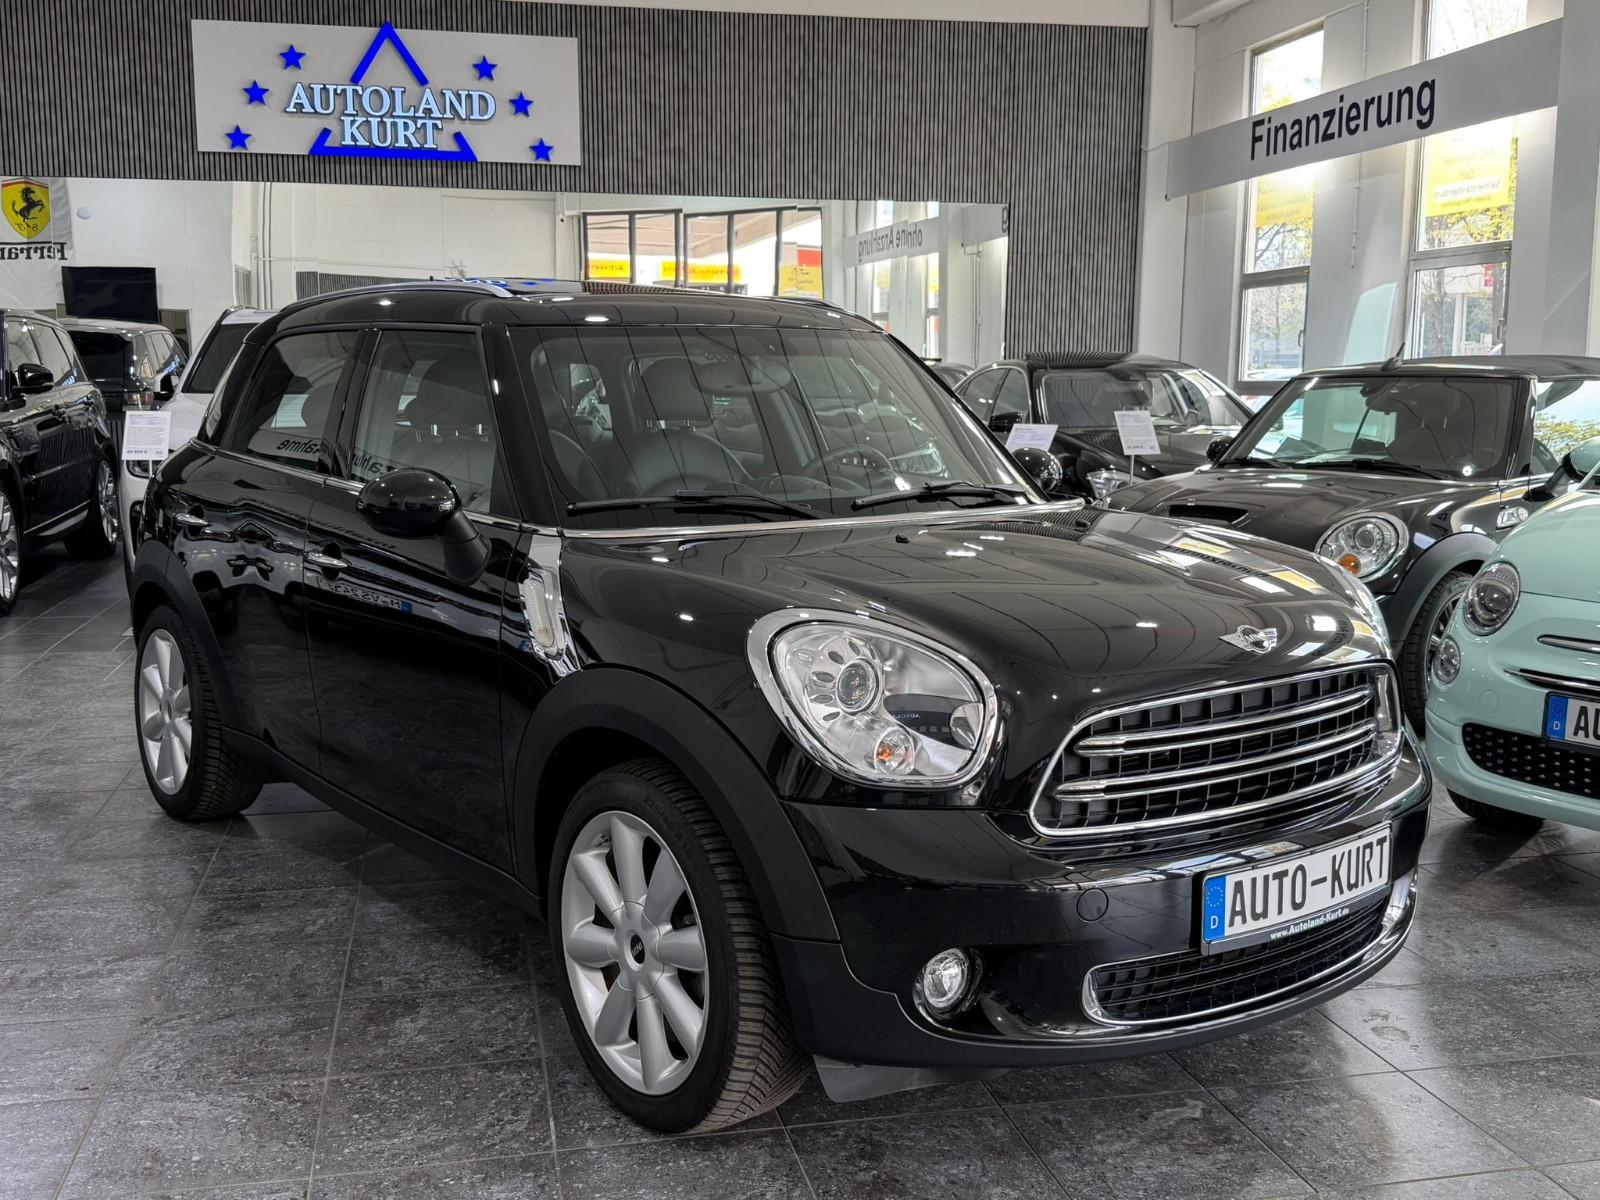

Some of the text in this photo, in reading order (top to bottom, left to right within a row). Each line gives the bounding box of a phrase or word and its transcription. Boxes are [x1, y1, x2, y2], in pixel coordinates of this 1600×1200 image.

[285, 82, 496, 120] AUTOLAND
[1250, 78, 1436, 161] Finanzierung
[339, 115, 443, 148] KURT
[1210, 834, 1388, 929] D AUTO-KURT
[1270, 907, 1350, 941] www.Autoland-Kurt.de
